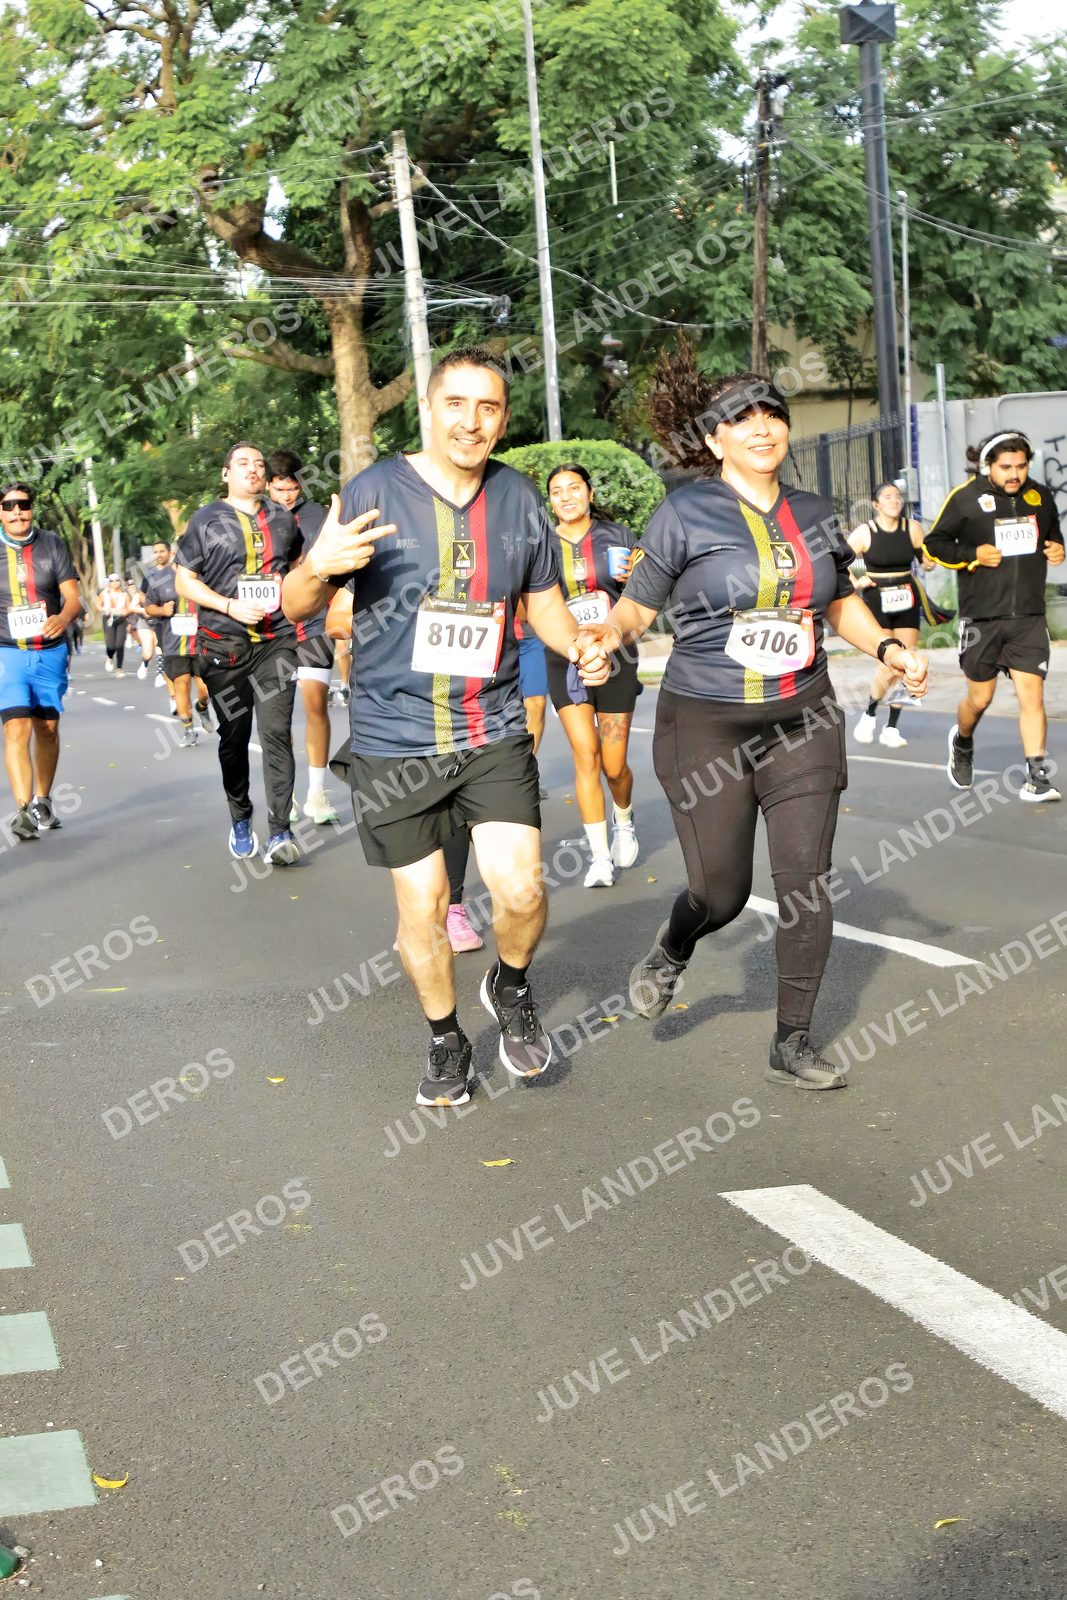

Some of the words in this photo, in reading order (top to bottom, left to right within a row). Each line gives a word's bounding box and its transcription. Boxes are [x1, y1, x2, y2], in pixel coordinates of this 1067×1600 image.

[242, 587, 275, 598] 11001
[13, 612, 44, 626] 11082
[428, 622, 488, 650] 8107
